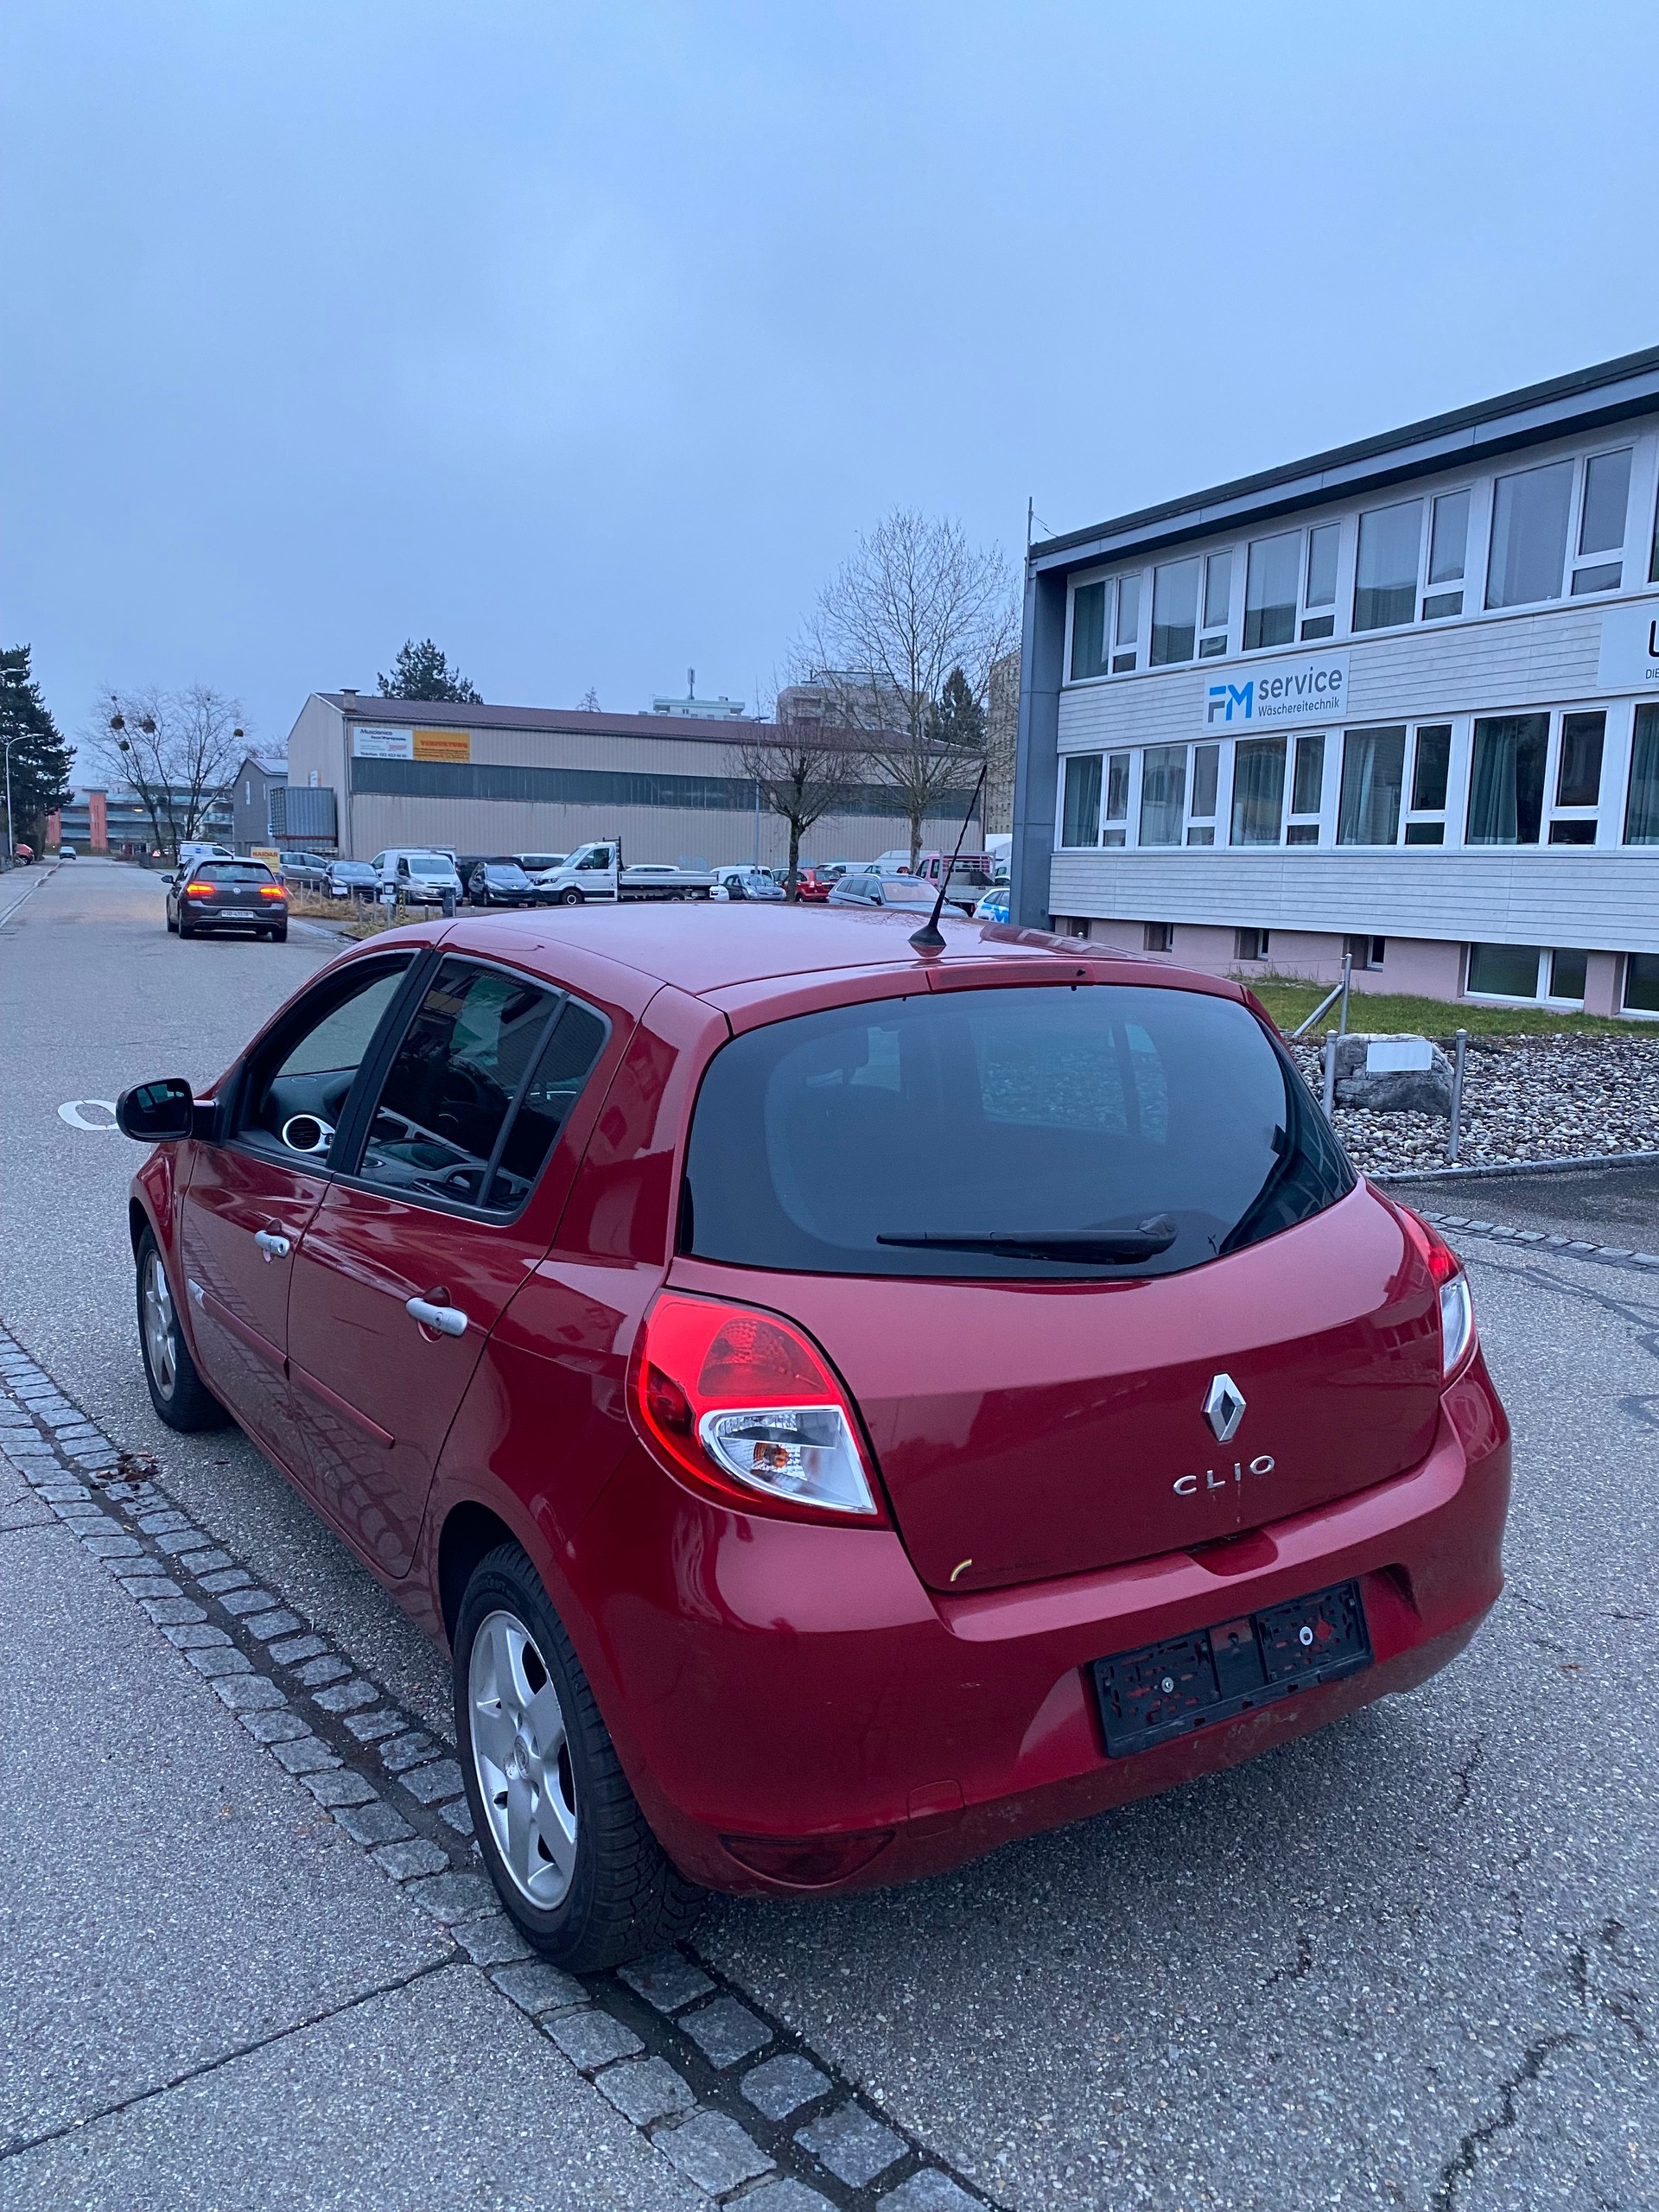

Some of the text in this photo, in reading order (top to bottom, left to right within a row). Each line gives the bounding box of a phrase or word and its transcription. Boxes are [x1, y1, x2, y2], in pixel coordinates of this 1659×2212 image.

[1208, 666, 1343, 723] FM service
[1258, 696, 1340, 717] Wäschereitechnik
[1173, 1455, 1275, 1496] CLIO
